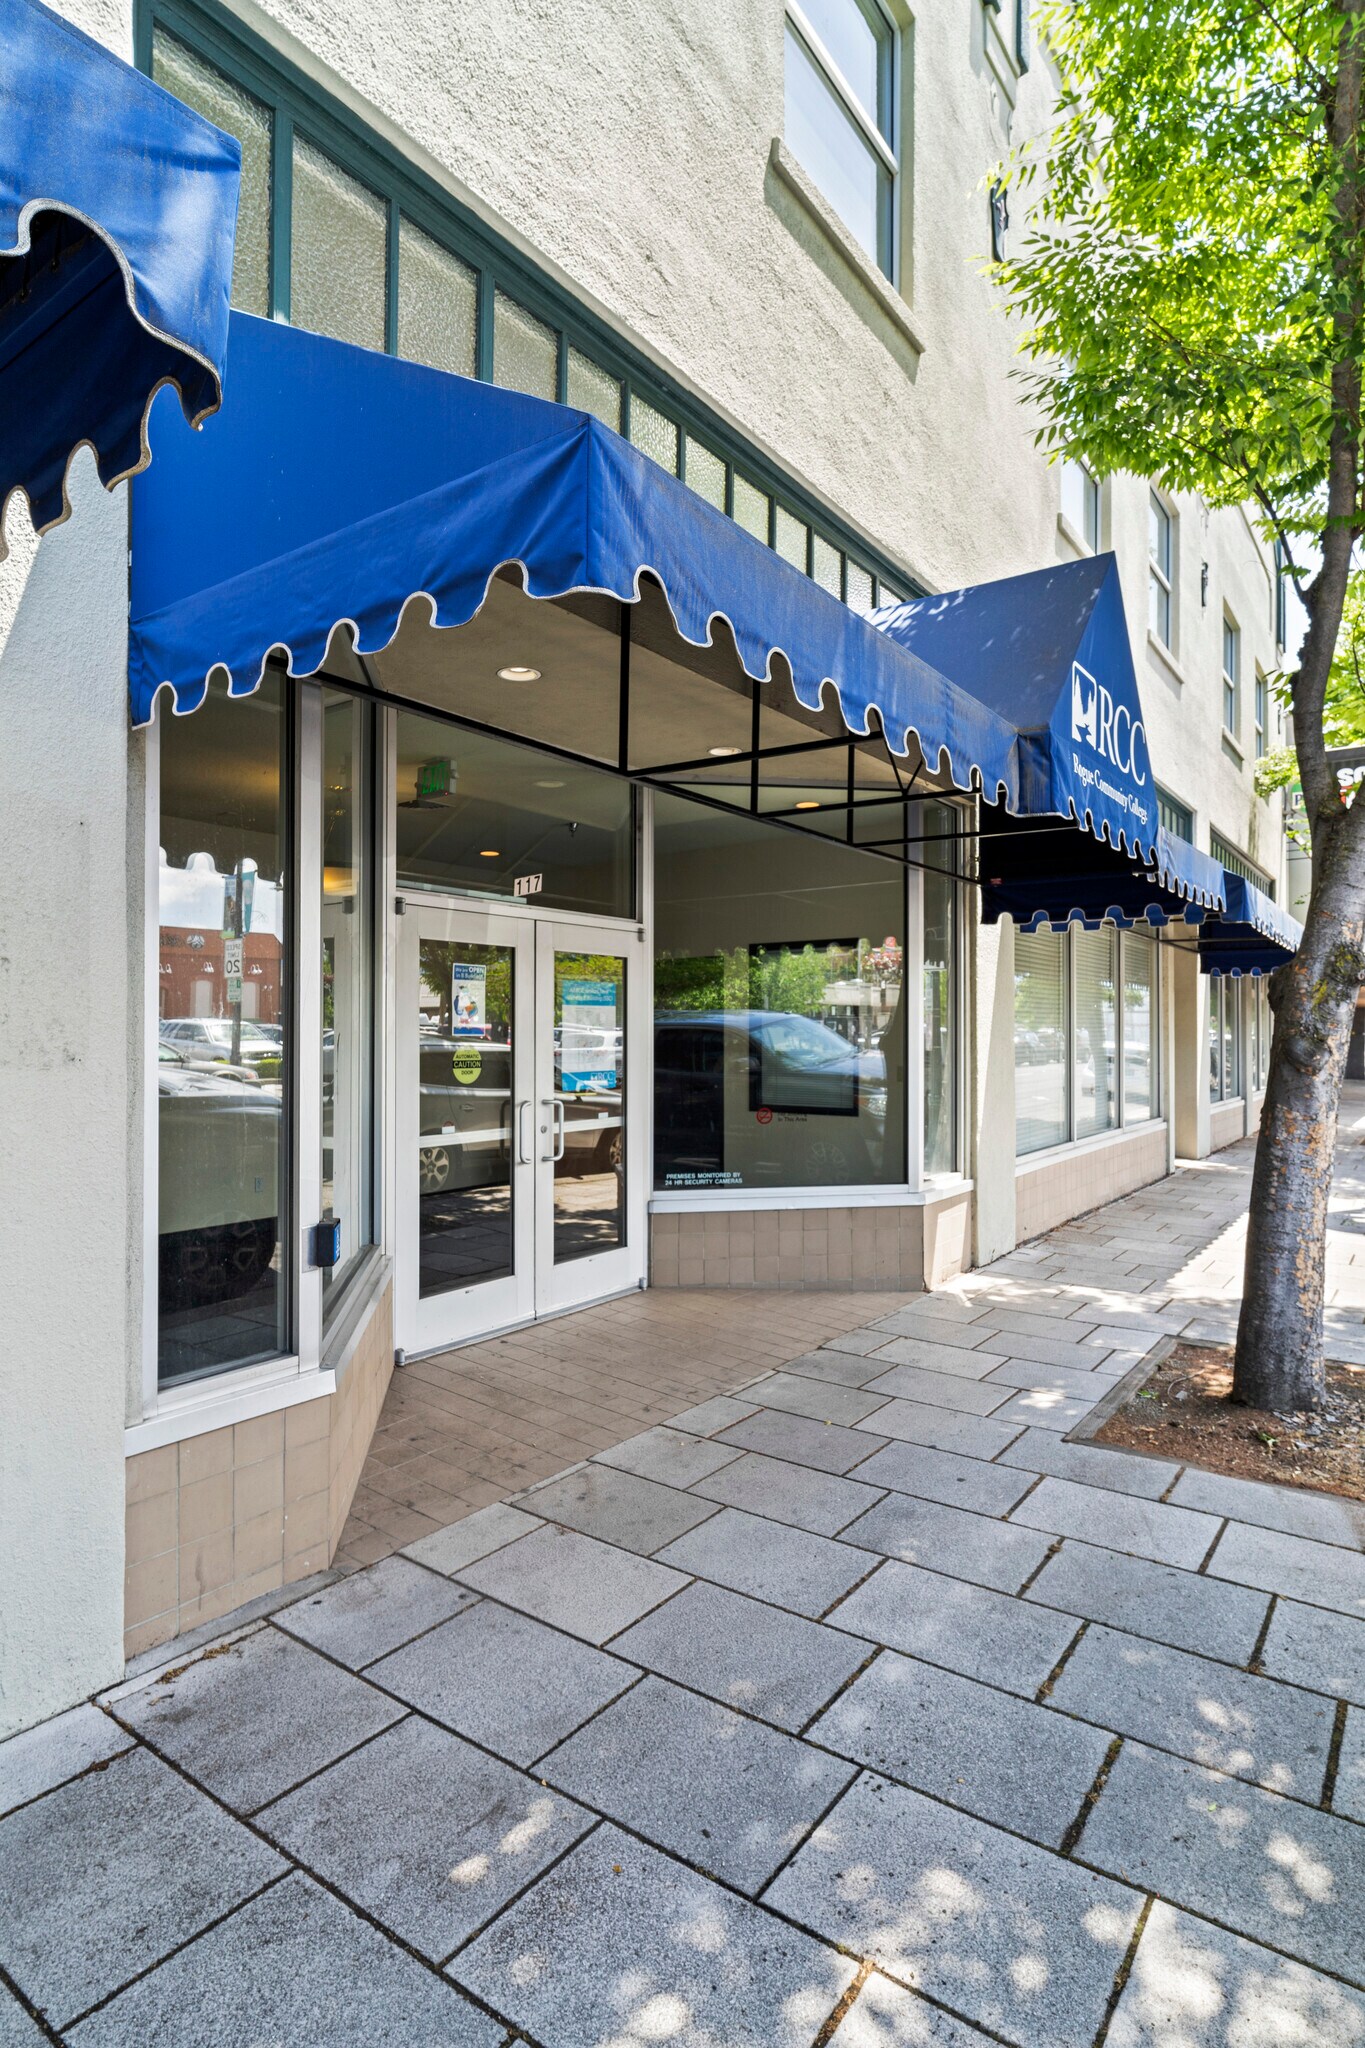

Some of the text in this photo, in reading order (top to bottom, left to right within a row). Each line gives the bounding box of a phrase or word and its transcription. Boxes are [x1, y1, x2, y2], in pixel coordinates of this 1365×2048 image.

[1098, 685, 1146, 787] RCC
[422, 761, 449, 794] EXIT
[1073, 753, 1094, 787] Rogue
[1094, 769, 1128, 813] Community
[517, 875, 540, 895] 117
[469, 966, 484, 974] OPEN
[697, 1171, 731, 1179] MONITORED
